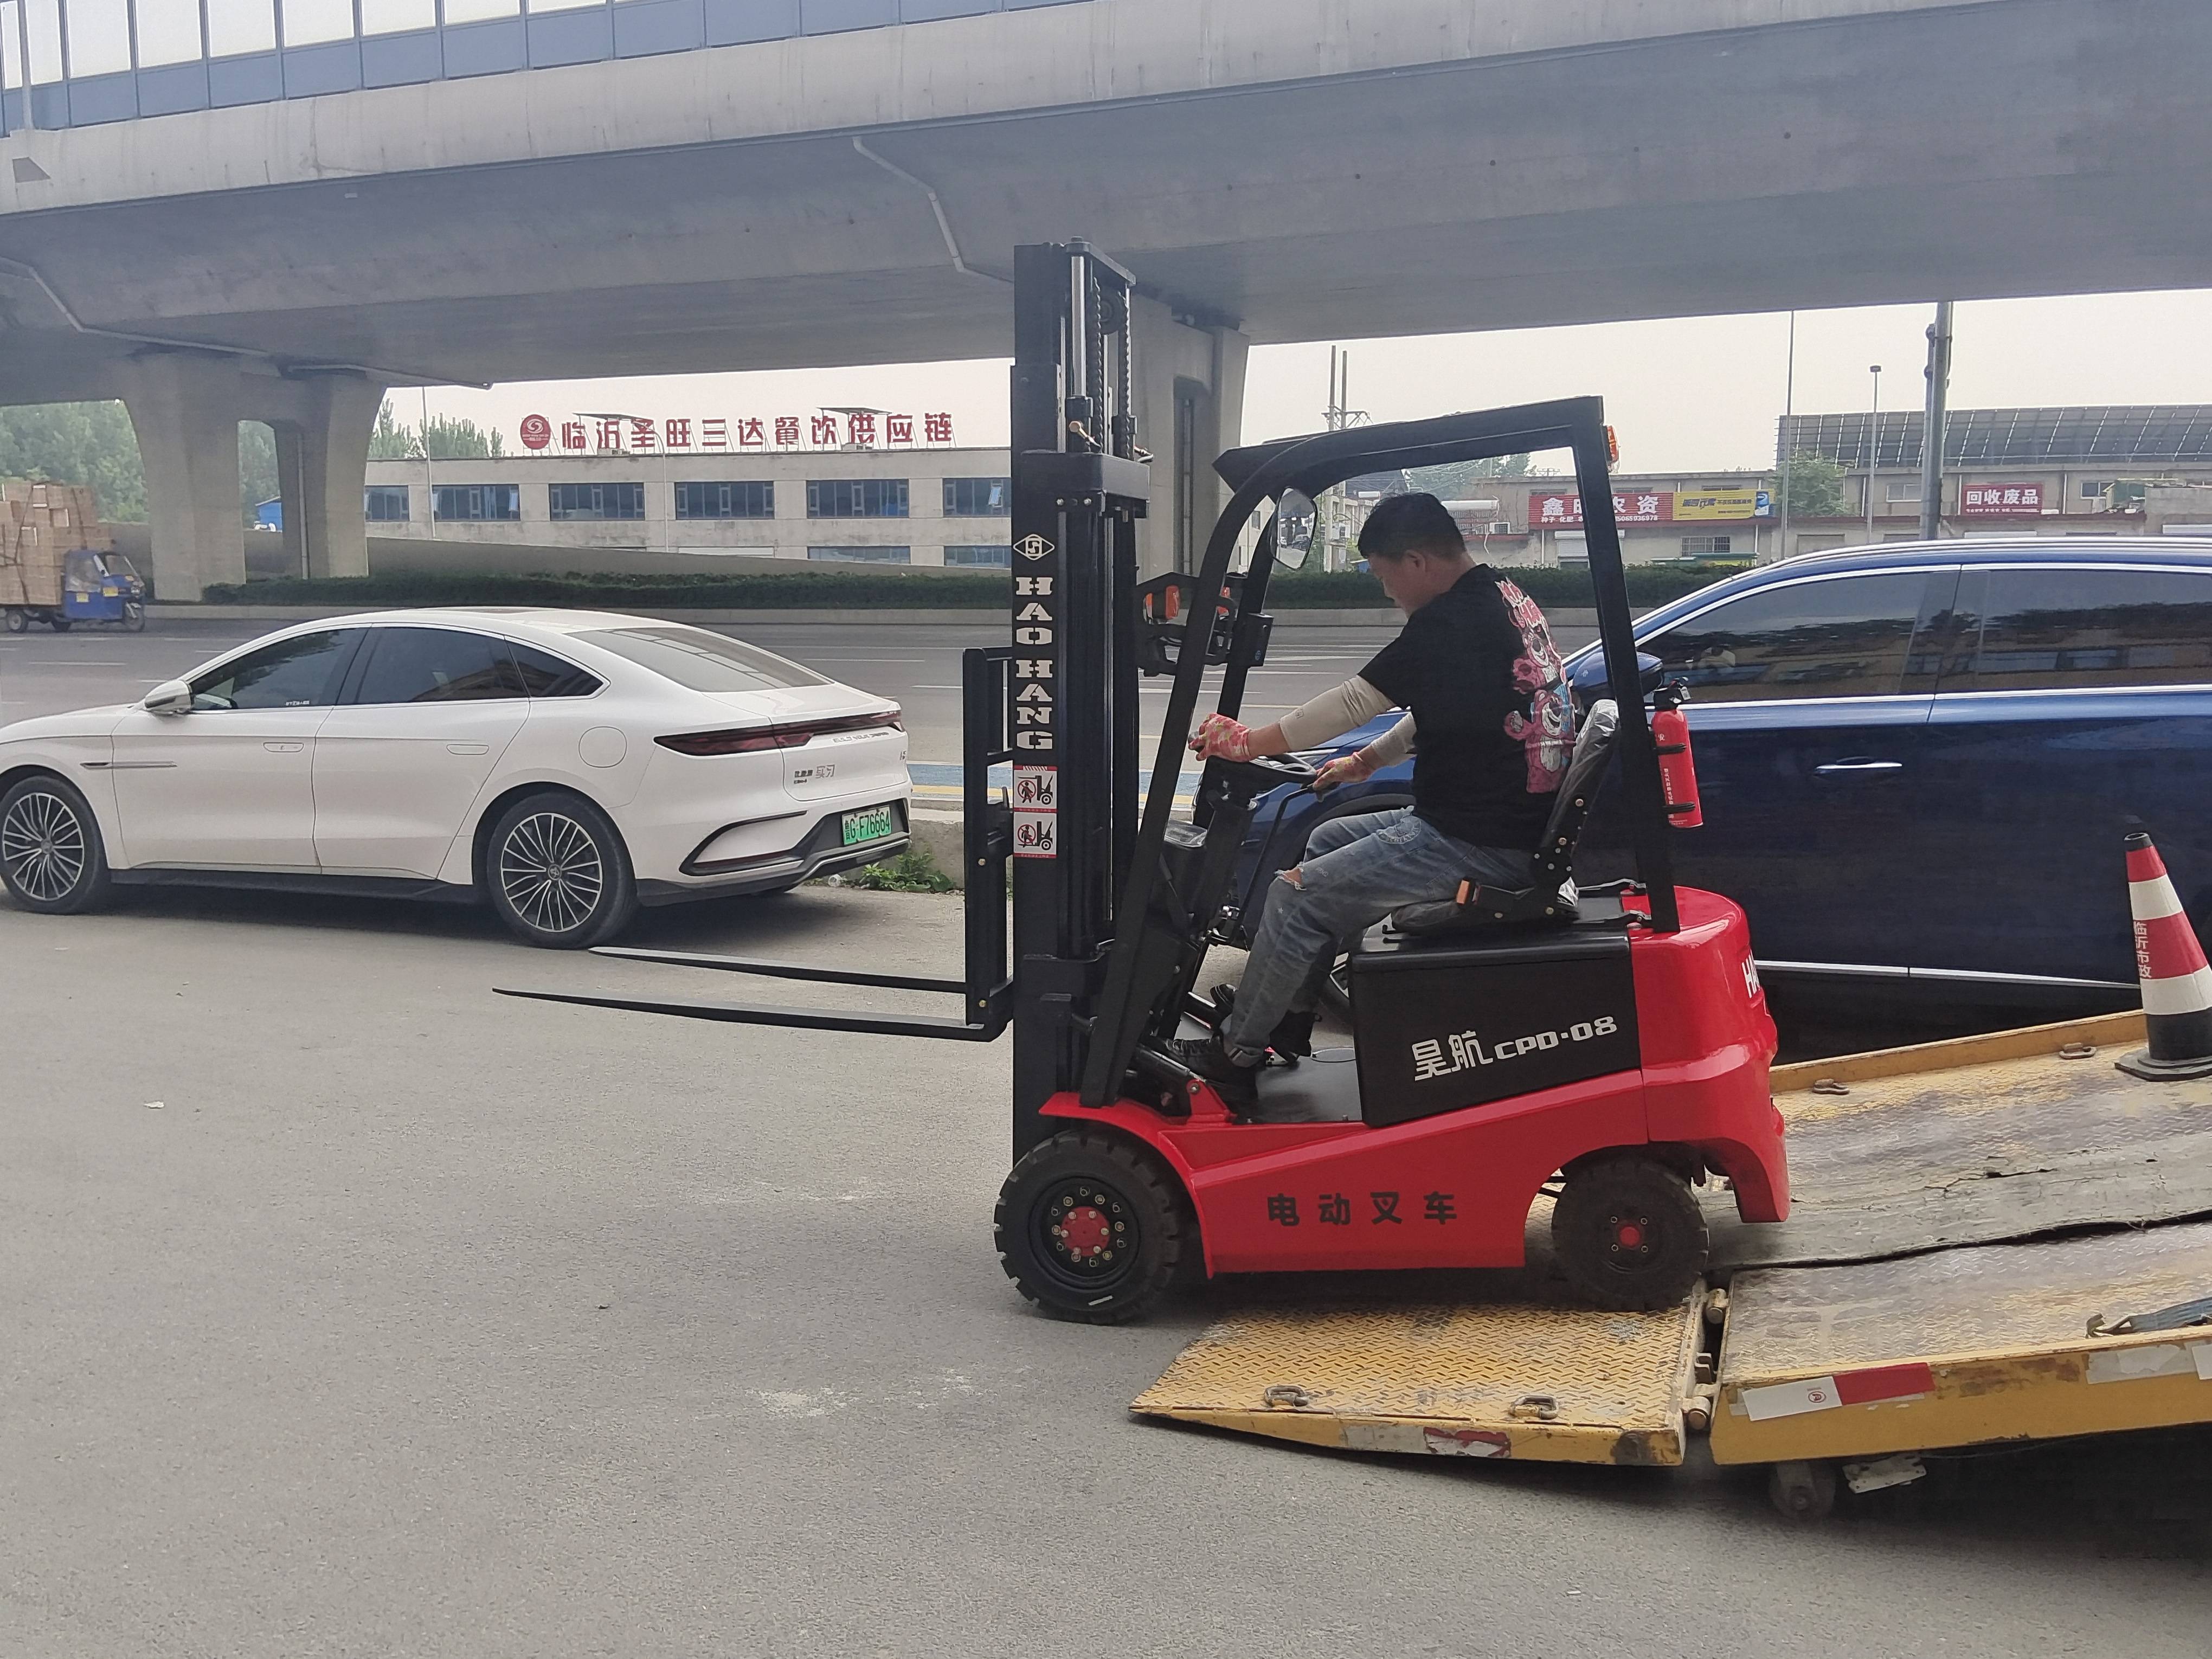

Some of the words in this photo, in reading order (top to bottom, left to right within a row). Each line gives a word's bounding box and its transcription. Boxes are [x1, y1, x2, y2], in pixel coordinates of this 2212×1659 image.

[562, 413, 953, 449] 临沂圣旺三达餐饮供应链
[1966, 489, 2039, 505] 回收废品
[1015, 576, 1053, 645] HAO
[1015, 659, 1053, 750] HANG
[1412, 1030, 1494, 1082] 昊航
[1266, 1191, 1458, 1226] 电动叉车
